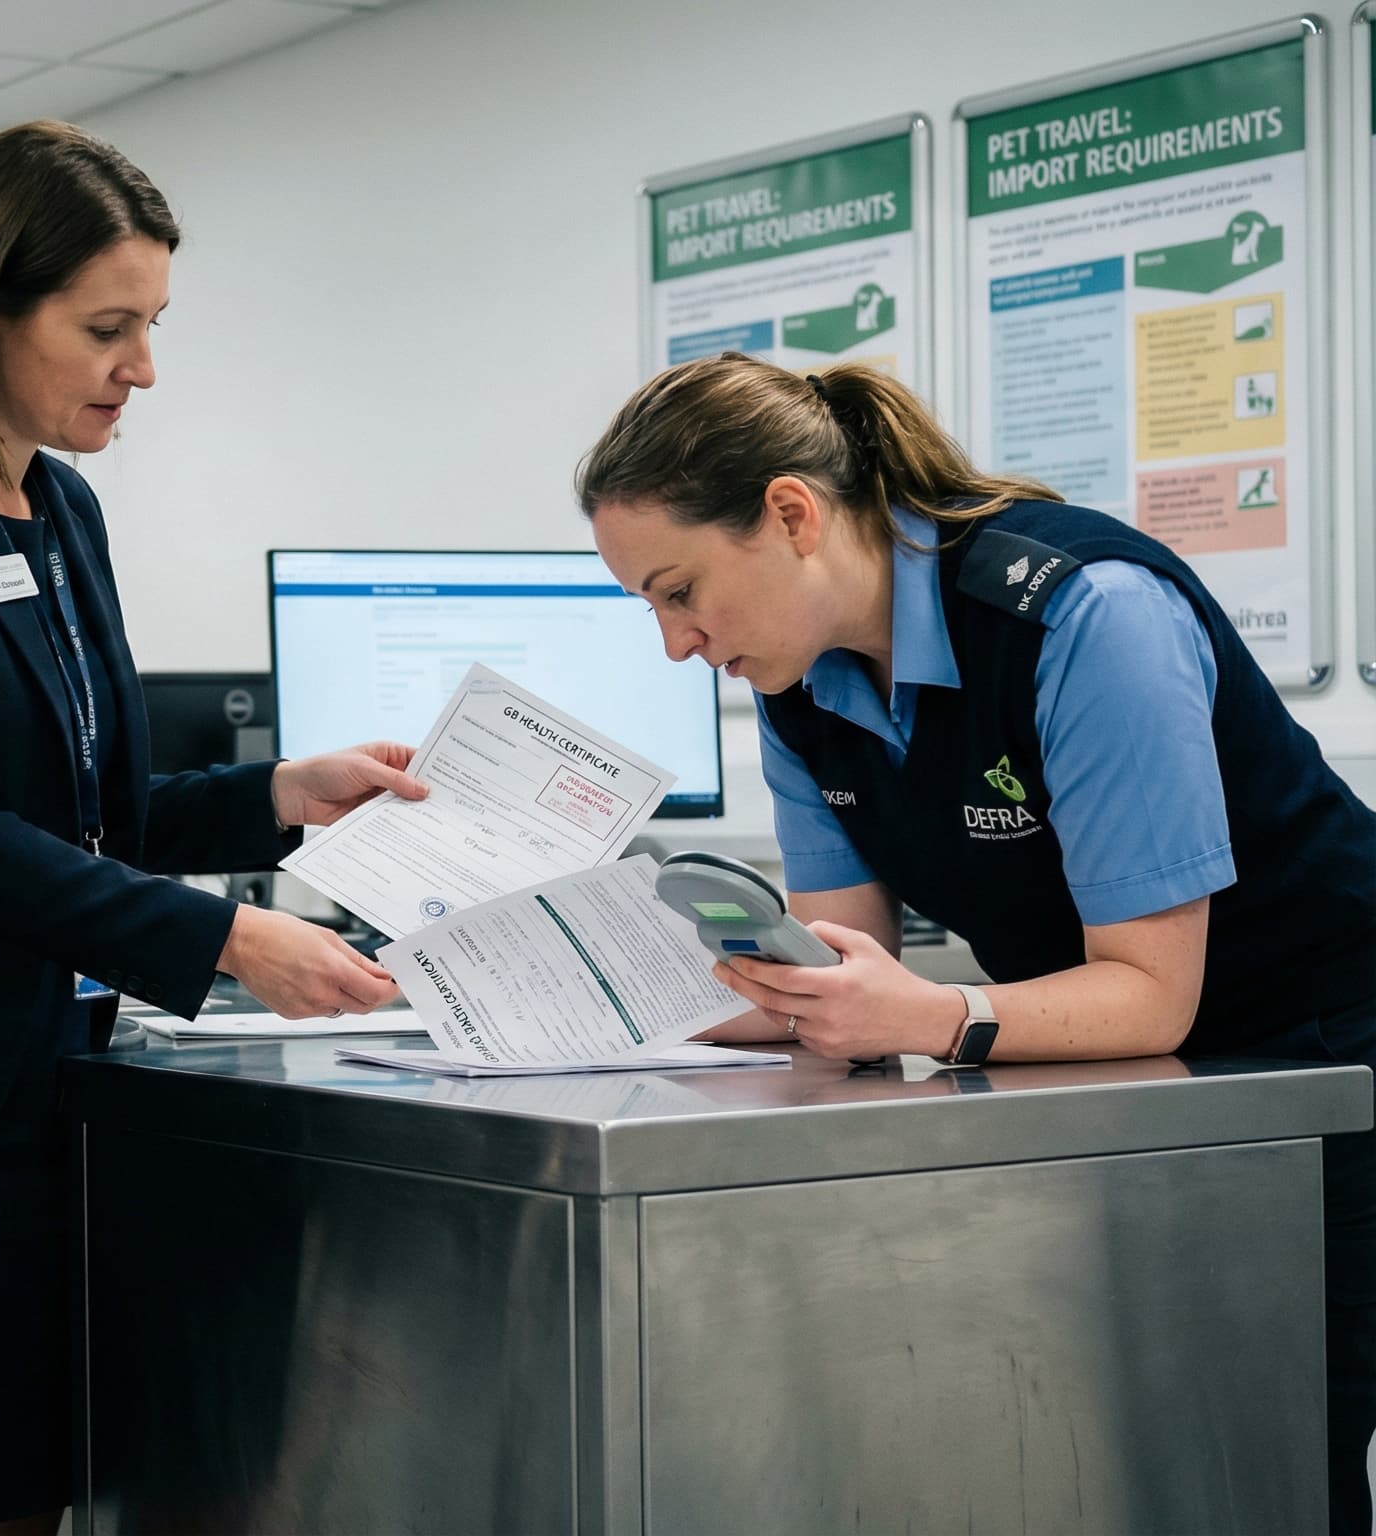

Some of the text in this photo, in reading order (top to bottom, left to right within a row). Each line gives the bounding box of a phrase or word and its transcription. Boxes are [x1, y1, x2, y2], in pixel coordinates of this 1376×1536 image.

[988, 106, 1133, 164] PET TRAVEL:
[988, 106, 1284, 199] IMPORT REQUIREMENTS
[666, 187, 782, 235] PET TRAVEL:
[666, 191, 897, 267] IMPORT REQUIREMENTS
[503, 706, 520, 720] GB
[519, 715, 560, 742] HEALTH
[964, 805, 1037, 830] DEFRA
